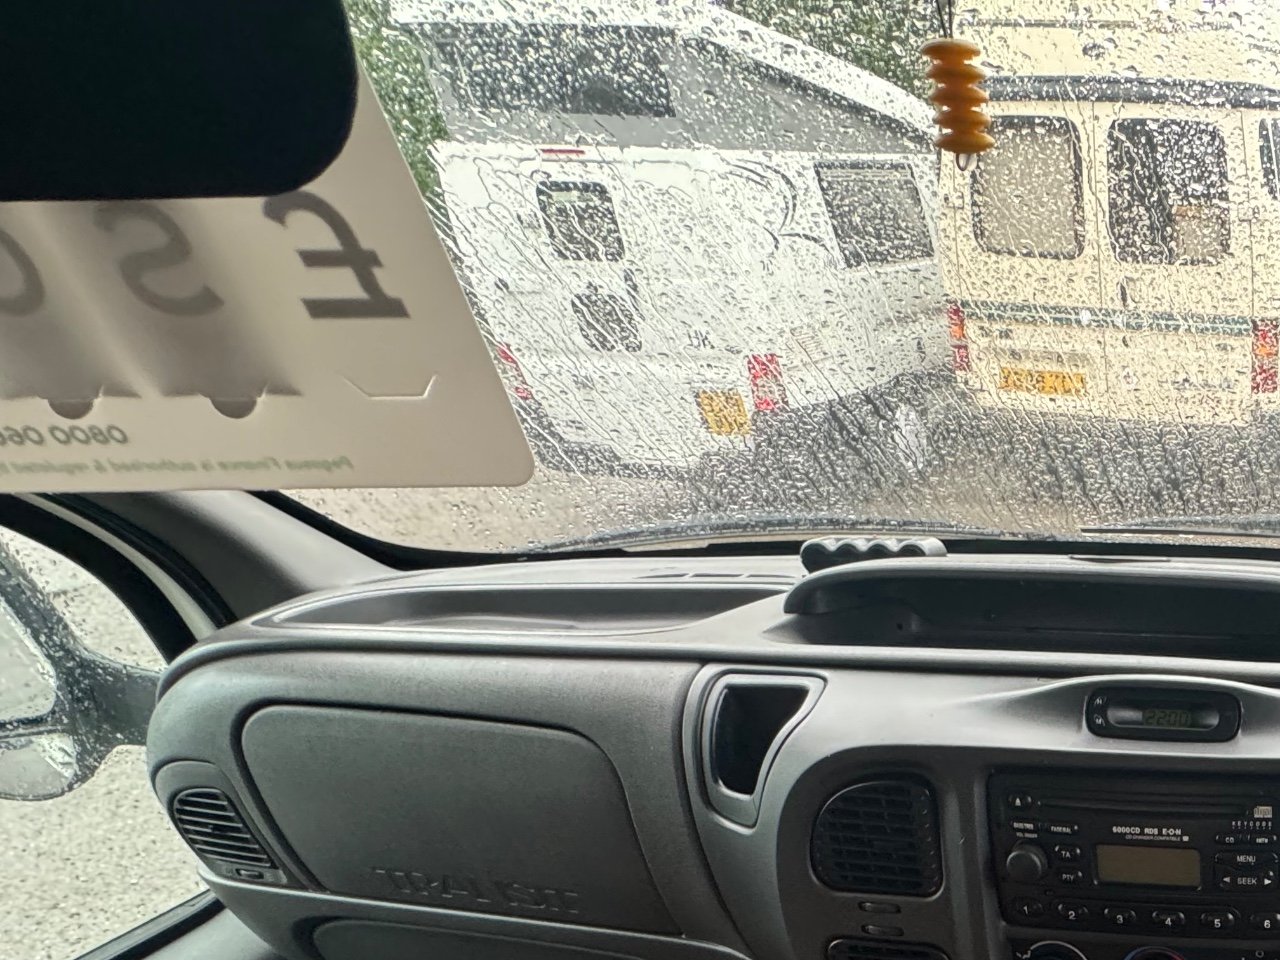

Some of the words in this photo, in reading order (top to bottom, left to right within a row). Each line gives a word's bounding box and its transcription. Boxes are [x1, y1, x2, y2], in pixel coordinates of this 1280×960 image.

[1237, 855, 1256, 863] MENU
[1237, 877, 1257, 885] SEEK
[1023, 905, 1028, 914] 1
[1068, 911, 1076, 920] 2
[1117, 915, 1123, 923] 3
[1164, 918, 1172, 926] 4
[1214, 919, 1221, 927] 5
[1264, 920, 1271, 929] 6
